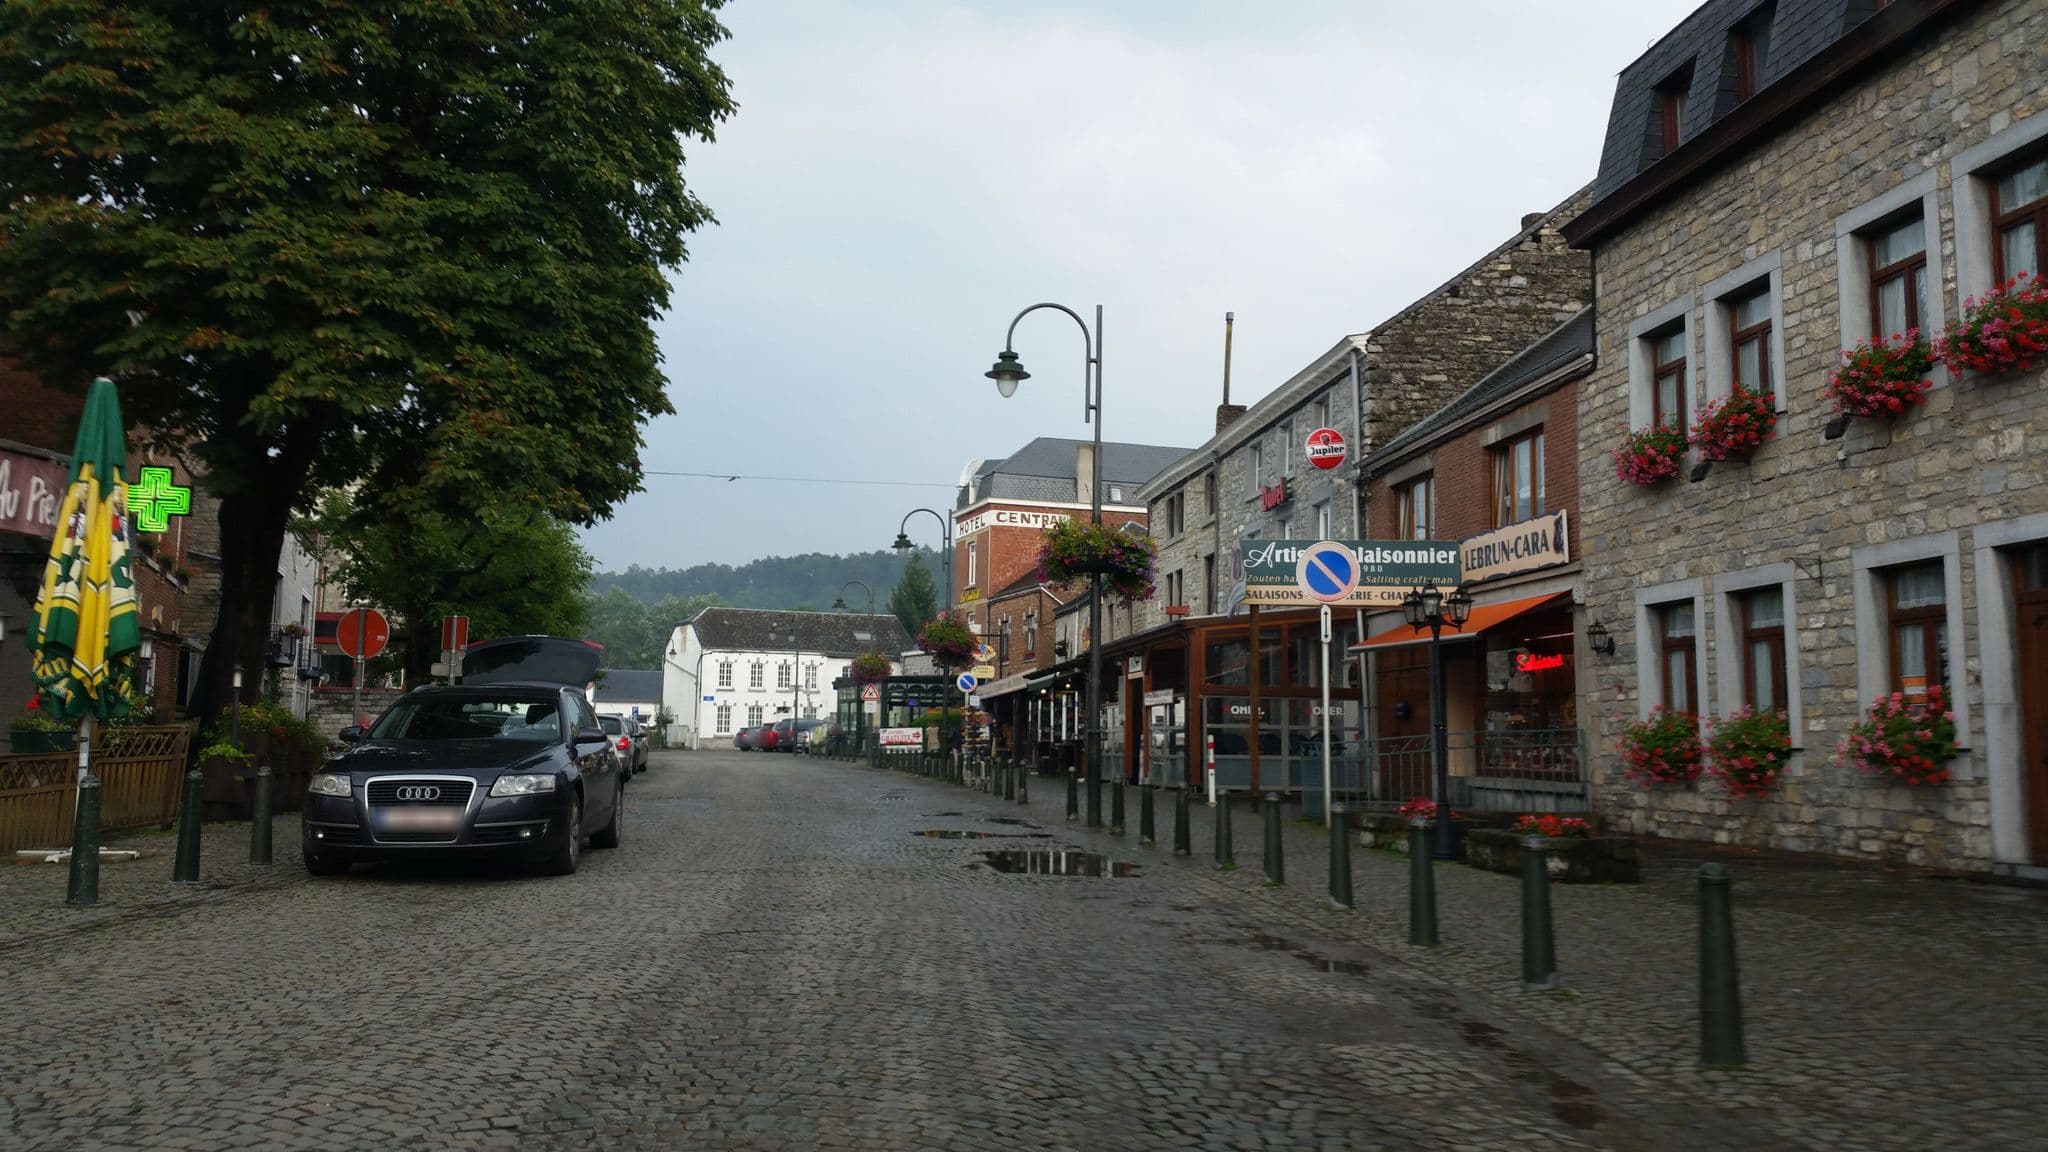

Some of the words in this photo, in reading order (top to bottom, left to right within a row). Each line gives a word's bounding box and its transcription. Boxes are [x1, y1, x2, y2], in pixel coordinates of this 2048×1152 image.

[1311, 445, 1344, 456] Jupiler
[960, 515, 985, 535] HOTEL
[1243, 541, 1305, 568] Artis
[1465, 529, 1549, 571] LEBRUN-CARA
[1362, 564, 1383, 572] 980
[1247, 574, 1281, 583] Zouten
[1366, 575, 1400, 585] Salting
[1245, 590, 1303, 600] SALAISONS
